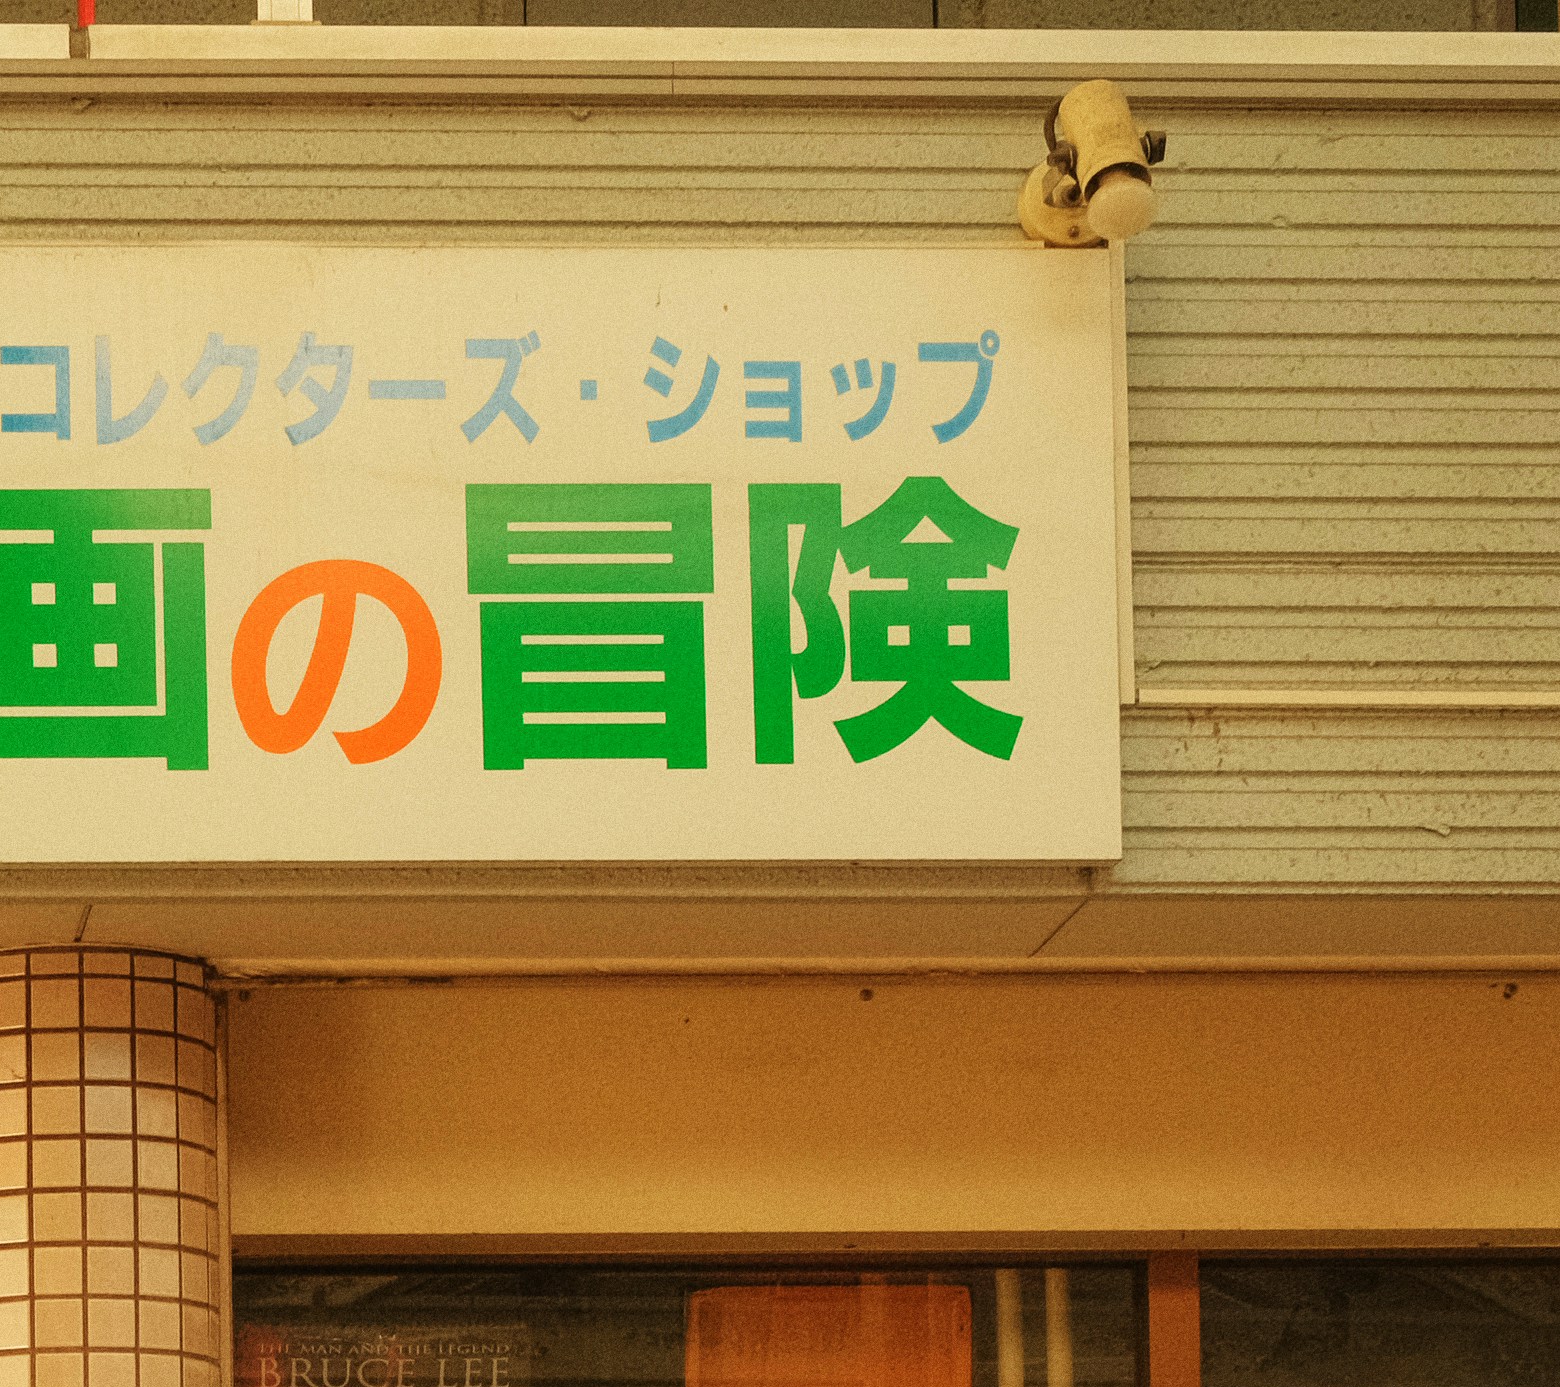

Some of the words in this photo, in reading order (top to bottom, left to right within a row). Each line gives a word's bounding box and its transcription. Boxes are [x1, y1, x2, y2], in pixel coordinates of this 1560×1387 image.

[301, 1344, 341, 1354] MAN
[348, 1343, 390, 1354] AND
[439, 1343, 510, 1354] LEGEND
